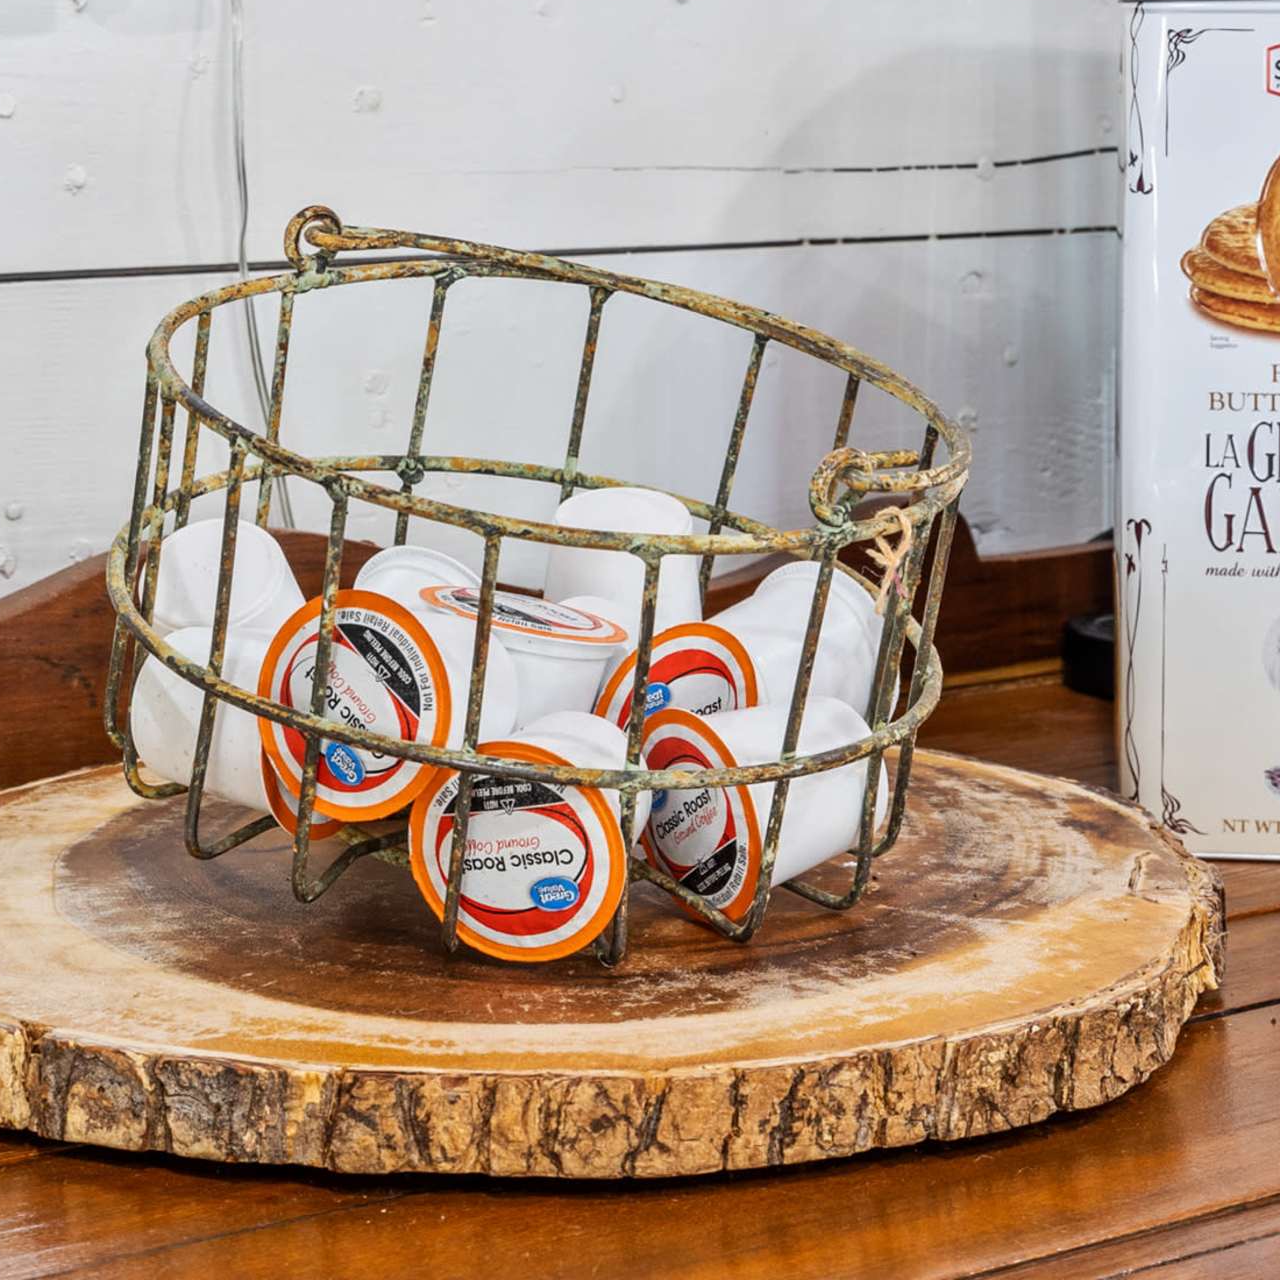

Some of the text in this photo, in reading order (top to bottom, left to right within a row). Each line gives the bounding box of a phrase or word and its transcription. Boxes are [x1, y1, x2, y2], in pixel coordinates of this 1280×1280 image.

[1205, 433, 1241, 469] LA
[1205, 563, 1246, 577] made
[342, 685, 377, 724] Ground
[422, 692, 433, 712] Not
[691, 697, 722, 716] oast
[655, 789, 712, 839] Classic Roast
[1222, 818, 1250, 834] NT
[496, 836, 541, 854] Ground
[510, 848, 574, 870] Classic
